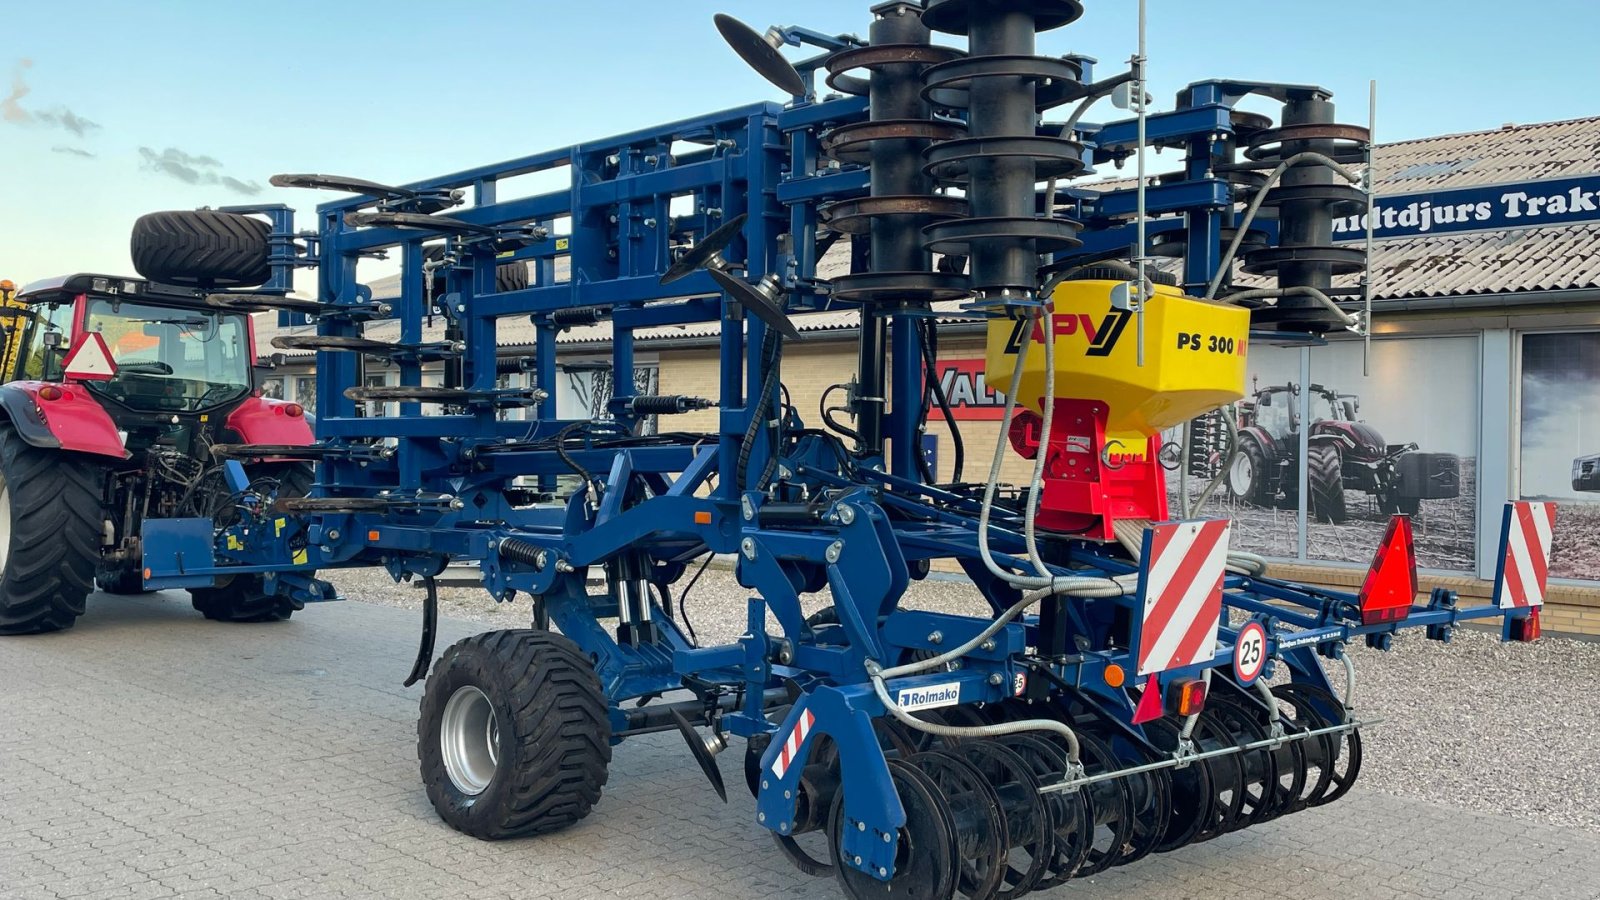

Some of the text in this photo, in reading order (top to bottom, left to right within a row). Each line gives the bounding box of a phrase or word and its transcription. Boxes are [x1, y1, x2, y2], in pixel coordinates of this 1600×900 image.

[1031, 309, 1098, 344] APV
[1177, 332, 1201, 351] PS
[1208, 335, 1233, 354] 300
[1240, 638, 1261, 666] 25
[911, 688, 958, 705] Rolmako
